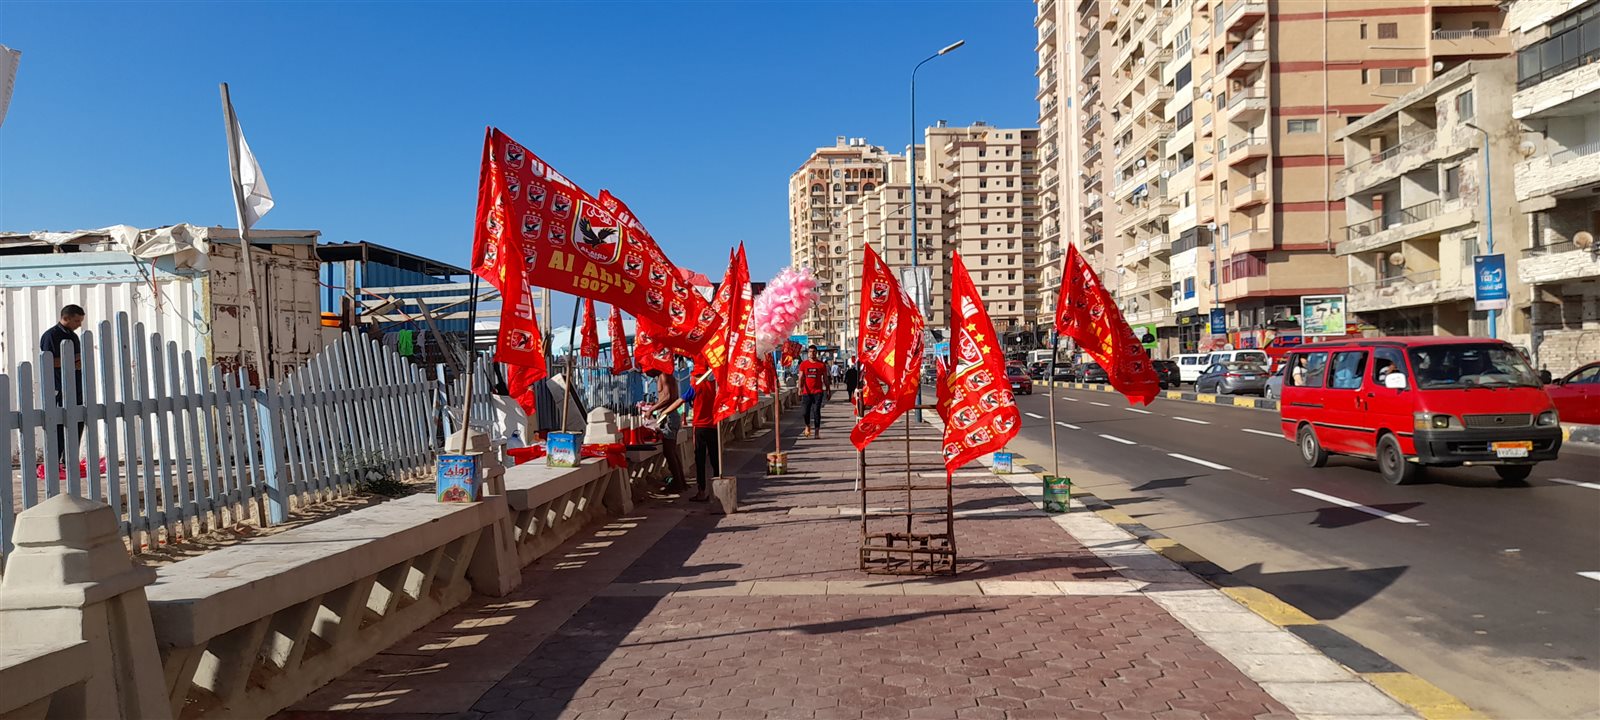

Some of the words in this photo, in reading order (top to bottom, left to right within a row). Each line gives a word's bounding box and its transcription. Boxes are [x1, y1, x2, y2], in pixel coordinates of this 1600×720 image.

[548, 250, 575, 273] Al
[582, 261, 636, 294] Ahly
[572, 275, 610, 293] 1907
